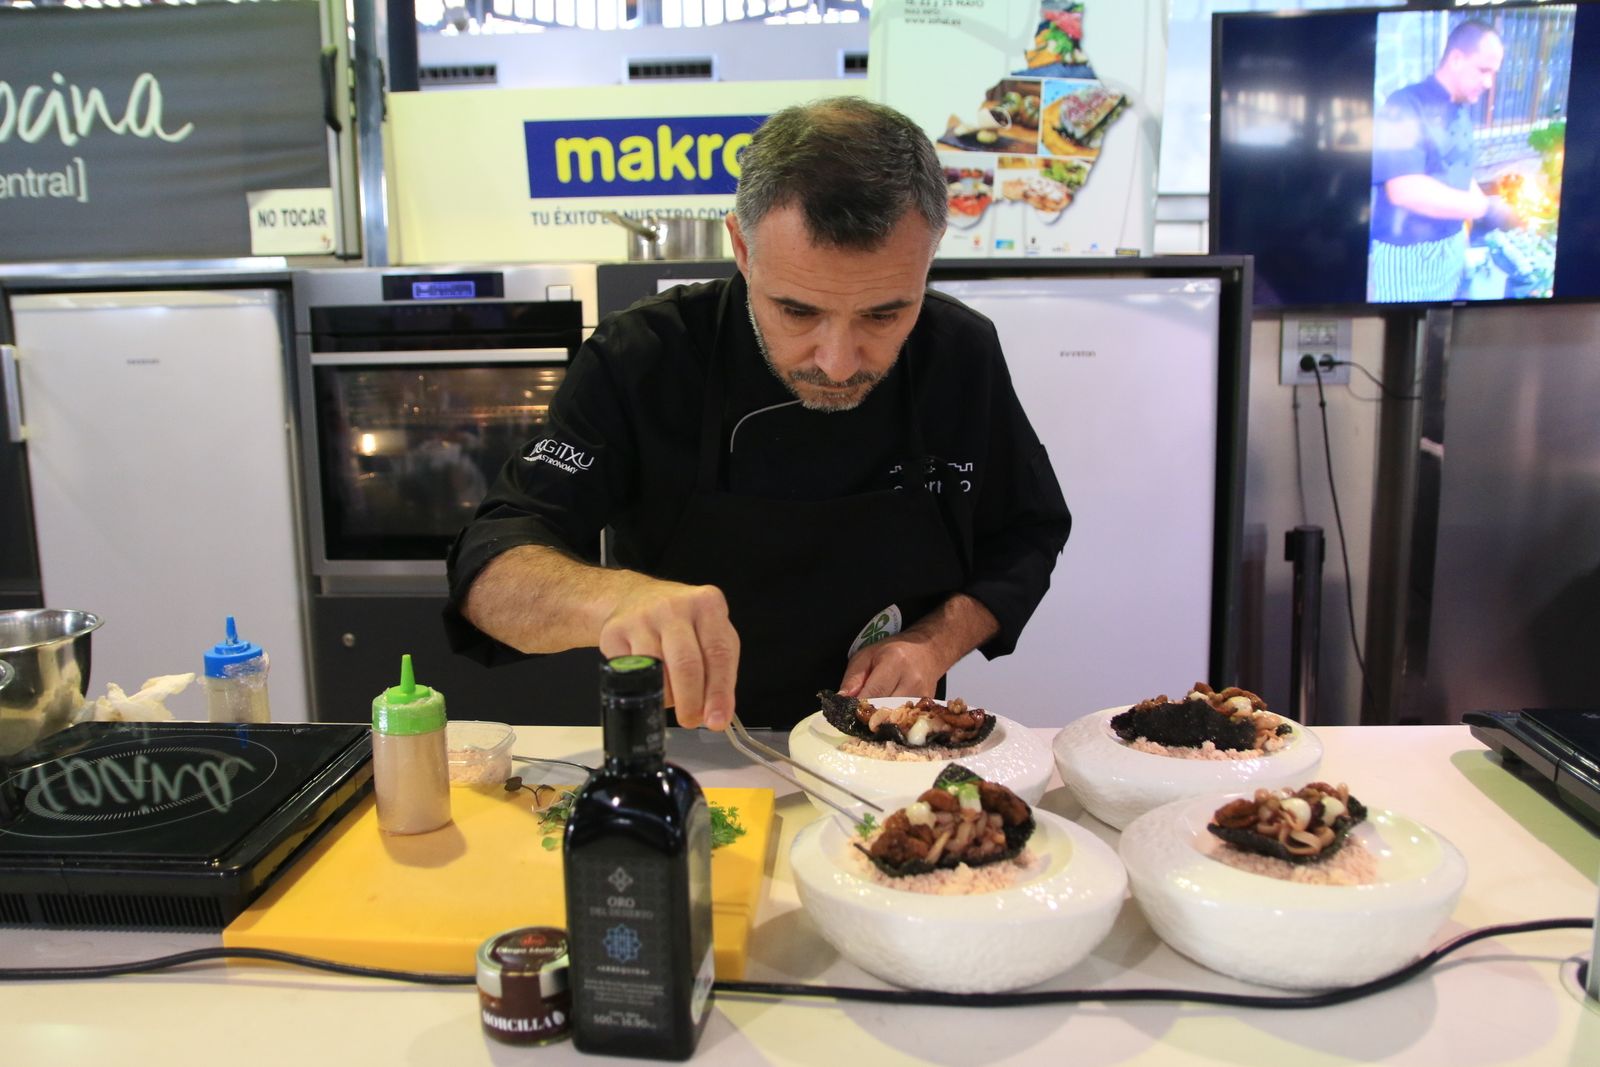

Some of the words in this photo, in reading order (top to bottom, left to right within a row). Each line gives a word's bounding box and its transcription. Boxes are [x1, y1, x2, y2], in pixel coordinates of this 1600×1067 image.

[258, 210, 278, 227] NO
[282, 208, 327, 228] TOCAR
[531, 211, 549, 226] TU
[554, 206, 596, 226] ÉXITO
